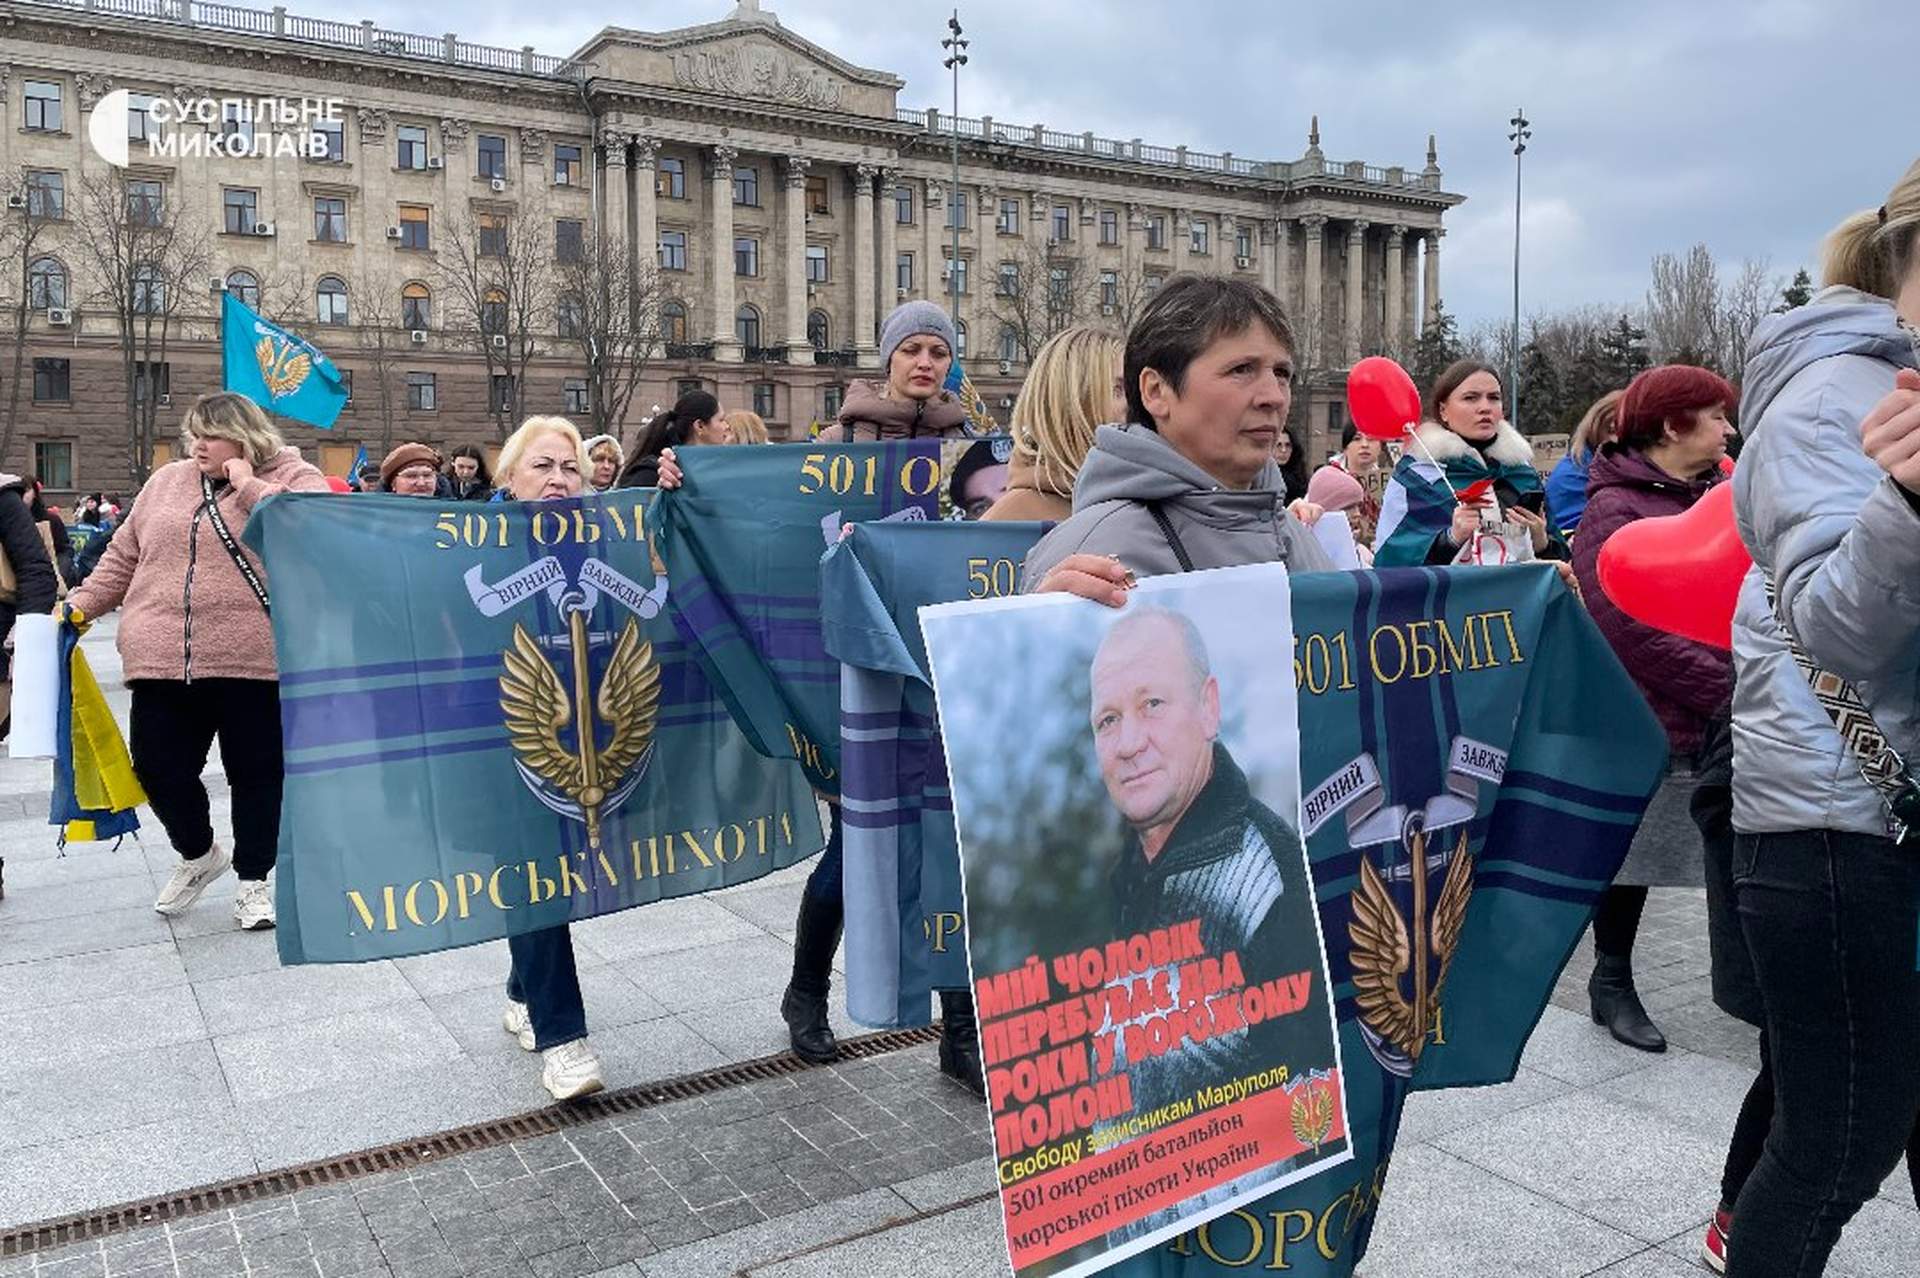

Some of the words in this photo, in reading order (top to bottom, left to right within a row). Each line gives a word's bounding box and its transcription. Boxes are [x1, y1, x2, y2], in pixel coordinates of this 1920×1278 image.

[799, 454, 876, 495] 501
[435, 512, 509, 549] 501
[498, 559, 564, 605] ВІРНИЙ
[583, 561, 650, 610] ЗАВЖДИ
[1369, 610, 1524, 684] ОБМП
[1304, 762, 1365, 825] ВІРНИЙ
[345, 849, 619, 936] МОРСЬКА
[976, 954, 1050, 1019] МІЙ
[1053, 918, 1205, 992] ЧОЛОВІК
[983, 971, 1174, 1066] ПЕРЕБУВАЄ
[1179, 951, 1246, 1010] ДВА
[988, 1040, 1089, 1111] РОКИ
[1092, 1033, 1116, 1074] У
[1125, 971, 1312, 1063] ВОРОЖОМУ
[1000, 1139, 1081, 1183] Свободу
[1086, 1098, 1194, 1153] захисникам
[1197, 1064, 1289, 1109] Маріуполя
[1009, 1184, 1044, 1217] 501
[1049, 1152, 1140, 1200] окремий
[1144, 1114, 1244, 1163] батальйон
[1013, 1193, 1110, 1251] морської
[1114, 1174, 1179, 1212] піхоти
[1182, 1140, 1260, 1183] України
